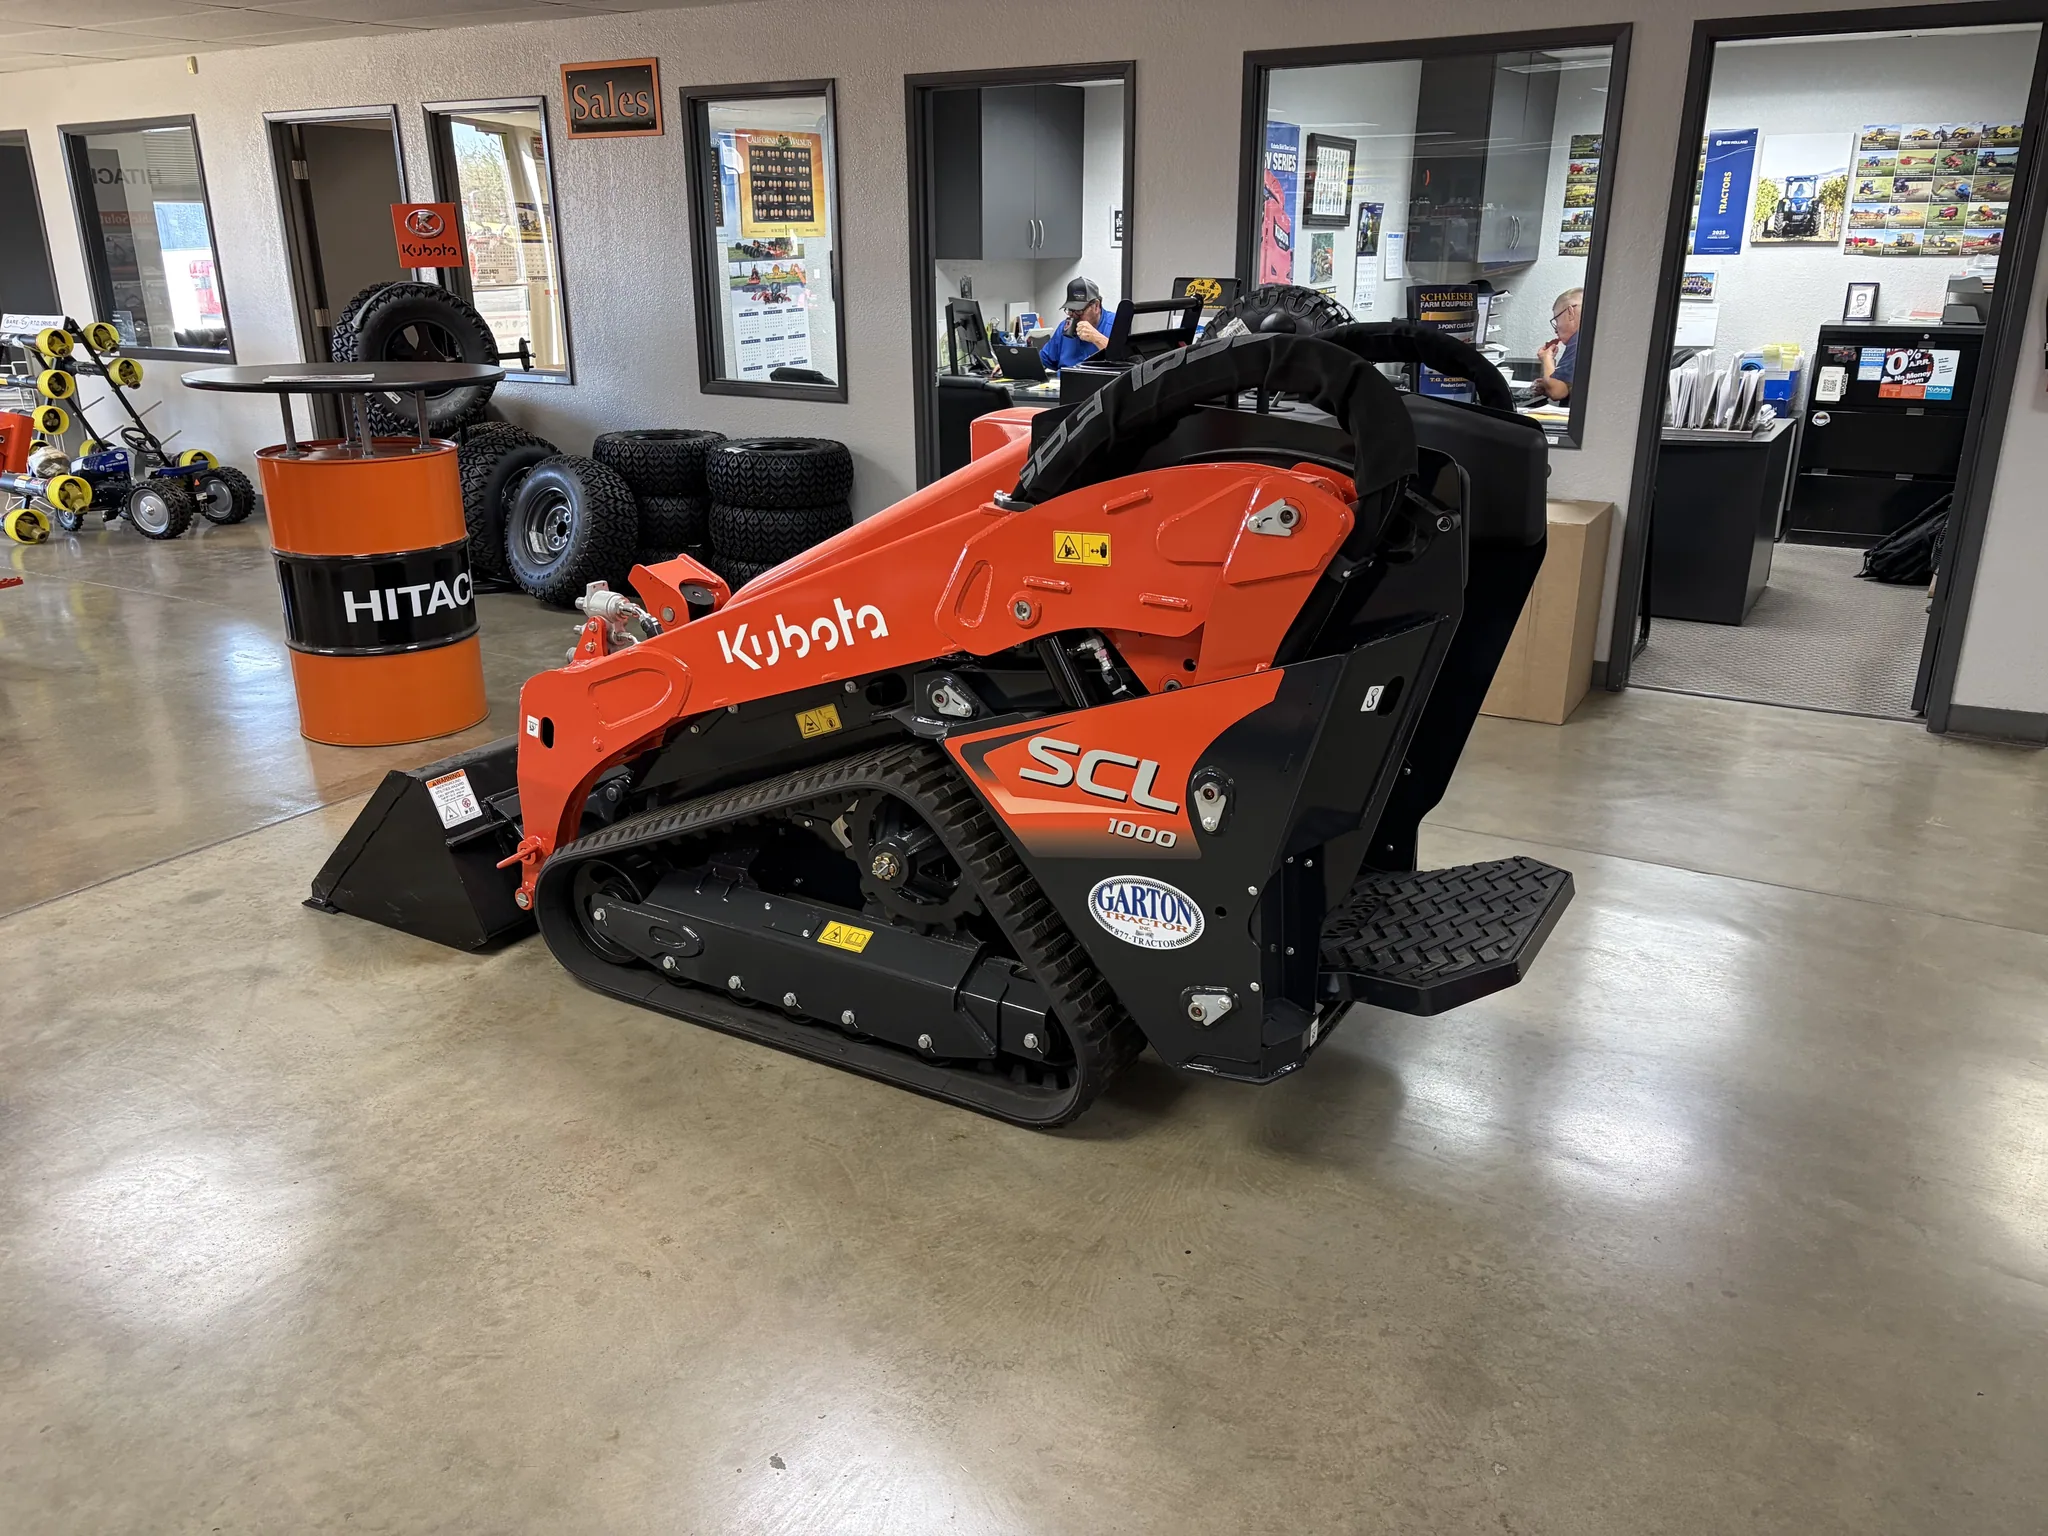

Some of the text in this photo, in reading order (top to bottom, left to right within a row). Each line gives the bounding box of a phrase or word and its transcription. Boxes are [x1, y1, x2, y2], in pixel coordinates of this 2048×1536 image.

[572, 81, 650, 120] Sales
[746, 135, 812, 147] CALIFORNIA WALNUTS
[1272, 152, 1297, 172] SERIES
[1718, 171, 1732, 214] TRACTORS
[402, 243, 457, 257] Kubota
[1420, 292, 1473, 301] SCHMEISER
[1420, 300, 1440, 308] FARM
[1886, 348, 1921, 376] 0%
[1840, 374, 1848, 395] WOODS
[1894, 371, 1931, 382] No Money
[1902, 377, 1924, 386] Down
[717, 597, 889, 670] Kubota
[435, 772, 461, 785] WARNING
[1019, 736, 1180, 815] SCL
[1108, 818, 1177, 848] 1000
[1097, 884, 1193, 927] GARTON
[1103, 910, 1188, 934] TRACTOR
